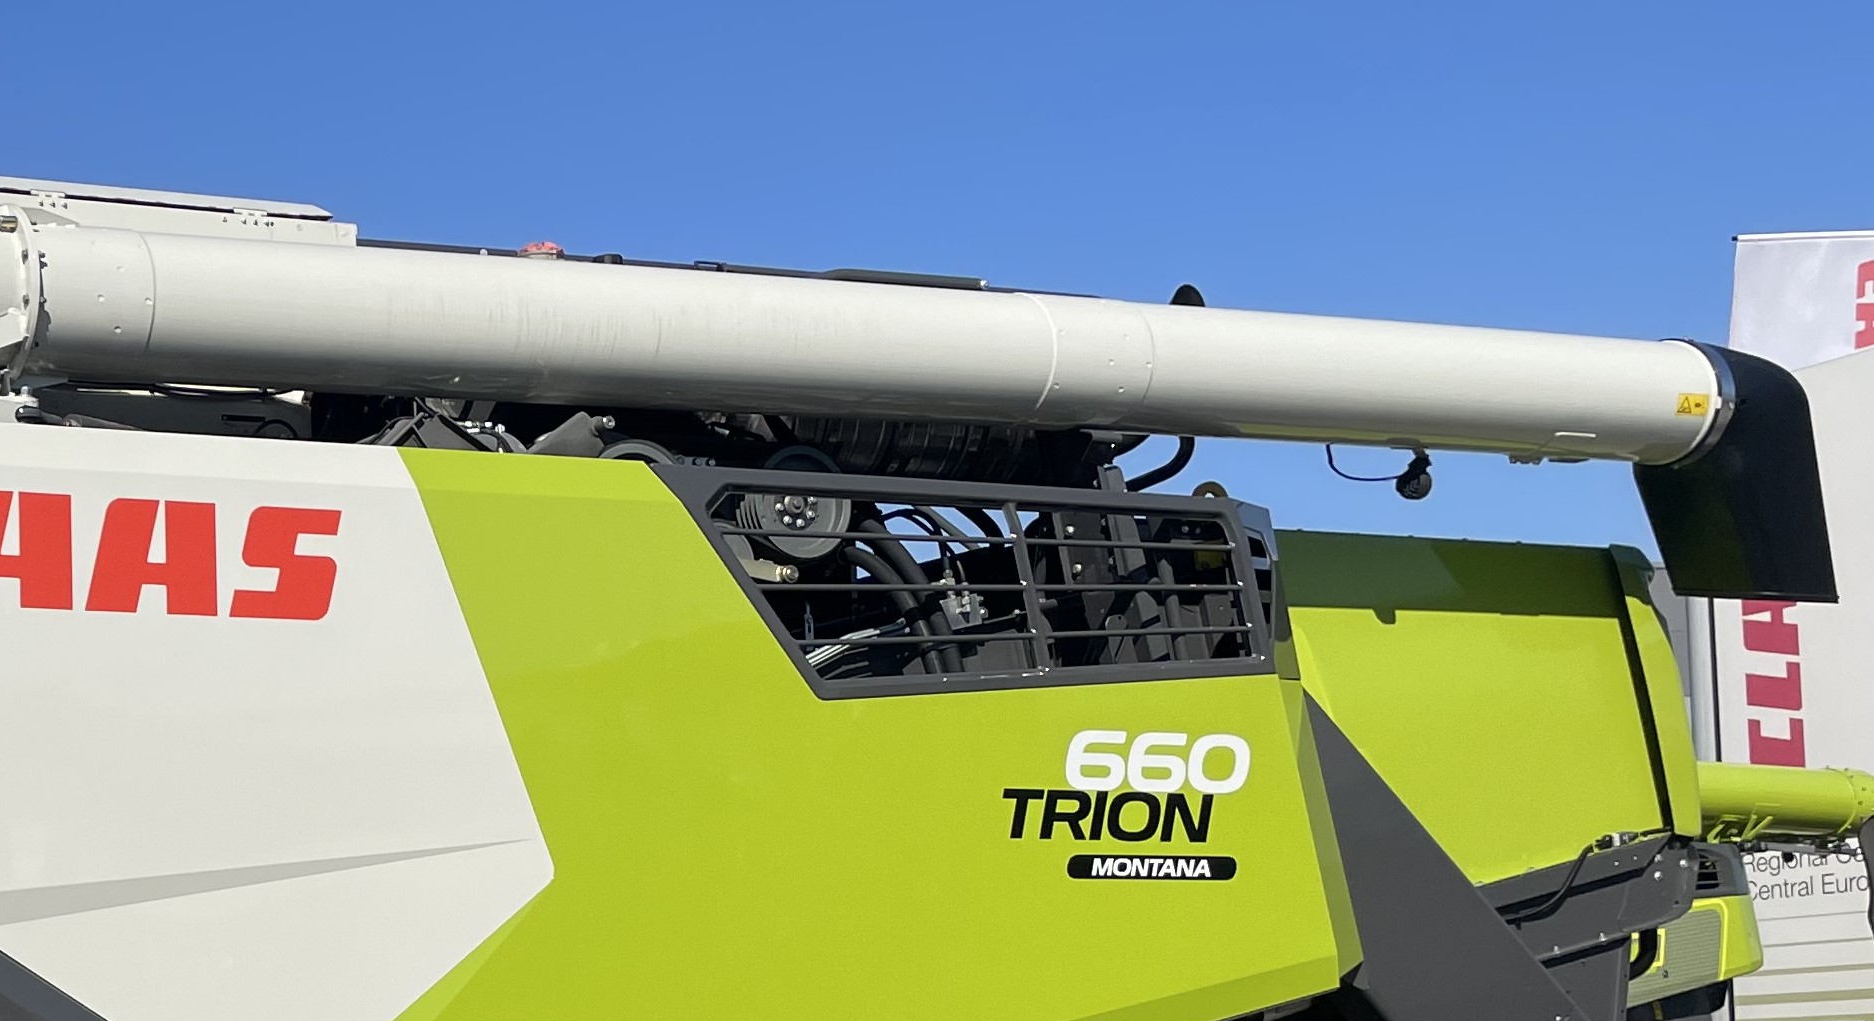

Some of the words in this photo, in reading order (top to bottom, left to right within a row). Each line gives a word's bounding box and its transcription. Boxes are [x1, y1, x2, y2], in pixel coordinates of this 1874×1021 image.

[1064, 729, 1251, 794] 660
[1002, 788, 1215, 843] TRION
[1090, 857, 1211, 878] MONTANA
